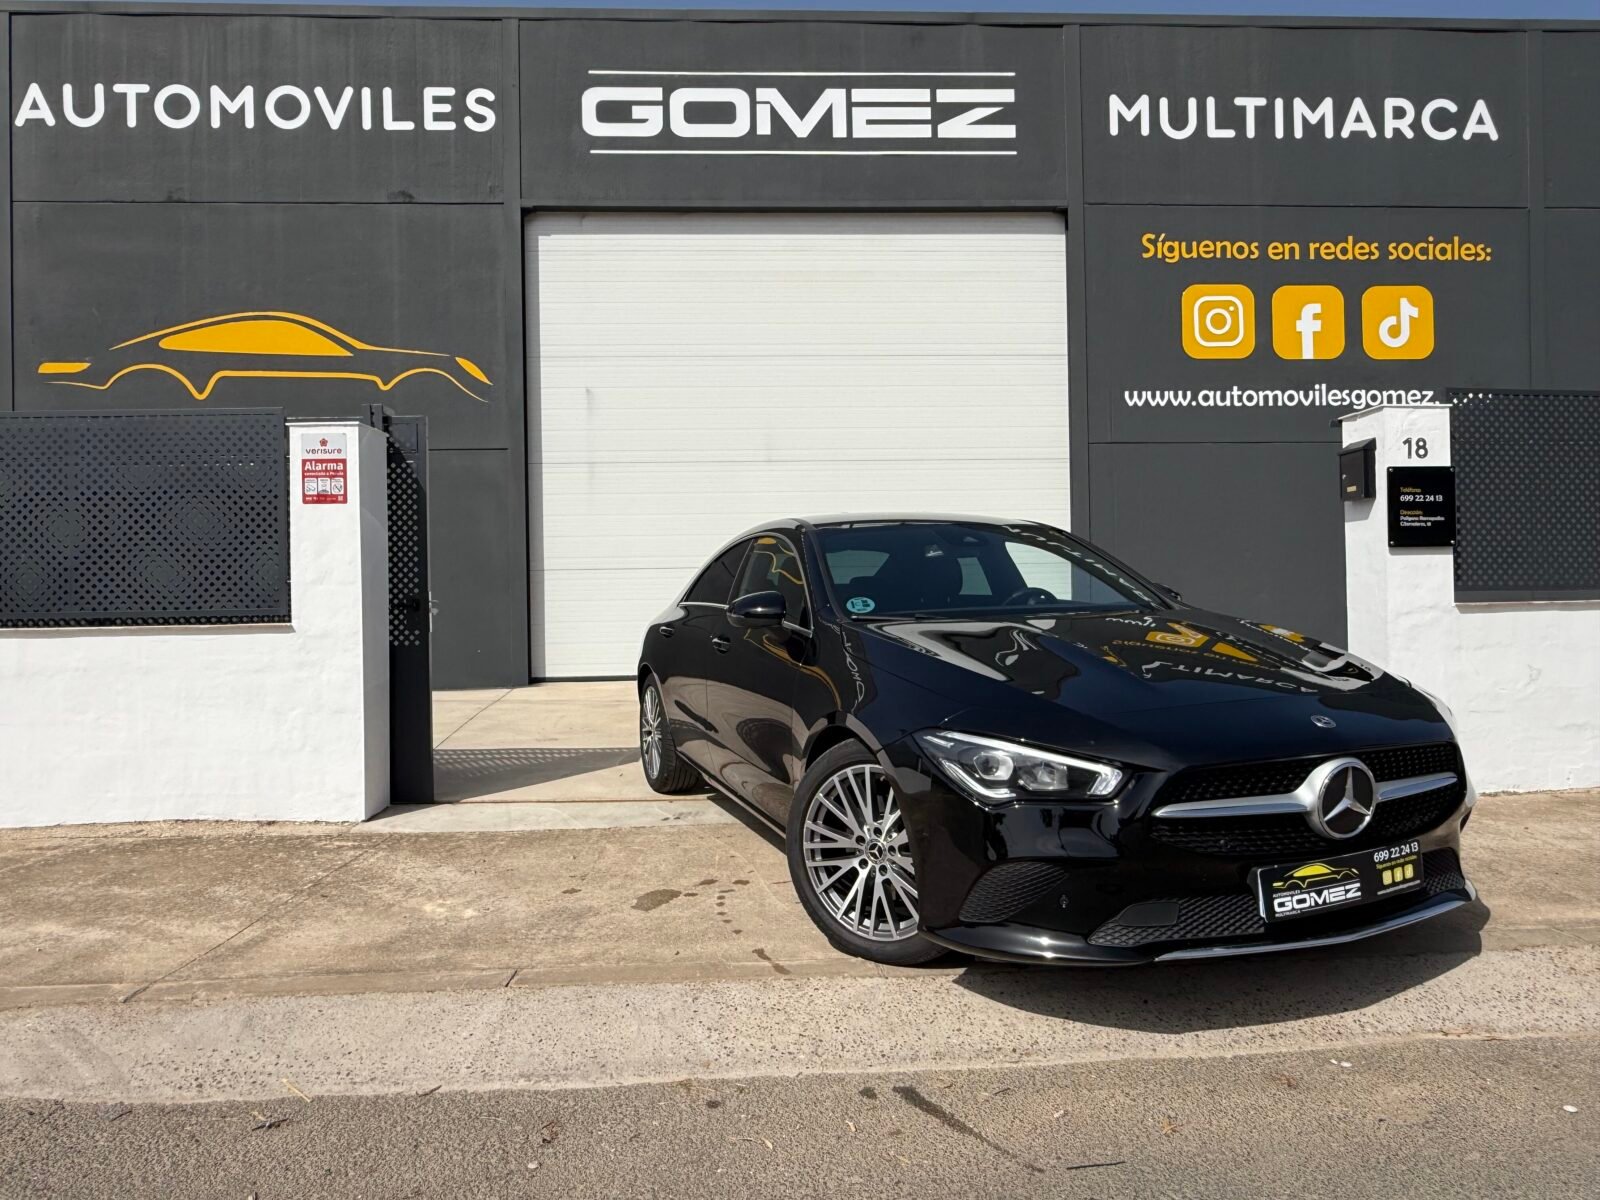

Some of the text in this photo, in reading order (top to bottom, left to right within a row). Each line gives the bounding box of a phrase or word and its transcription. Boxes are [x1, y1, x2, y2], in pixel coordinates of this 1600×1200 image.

[14, 82, 497, 133] AUTOMOVILES
[581, 86, 1017, 139] GOMEZ
[1109, 93, 1499, 141] MULTIMARCA
[1141, 233, 1492, 264] Síguenos en redes sociales:
[1124, 384, 1493, 410] www.automovilesgomez.
[1402, 437, 1429, 459] 18
[304, 461, 344, 471] Alarma
[1400, 494, 1443, 502] 699 22 24 13
[1373, 841, 1419, 863] 699 22 24 13
[1272, 890, 1301, 898] AUTOMOVILES
[1273, 882, 1362, 913] GOMEZ
